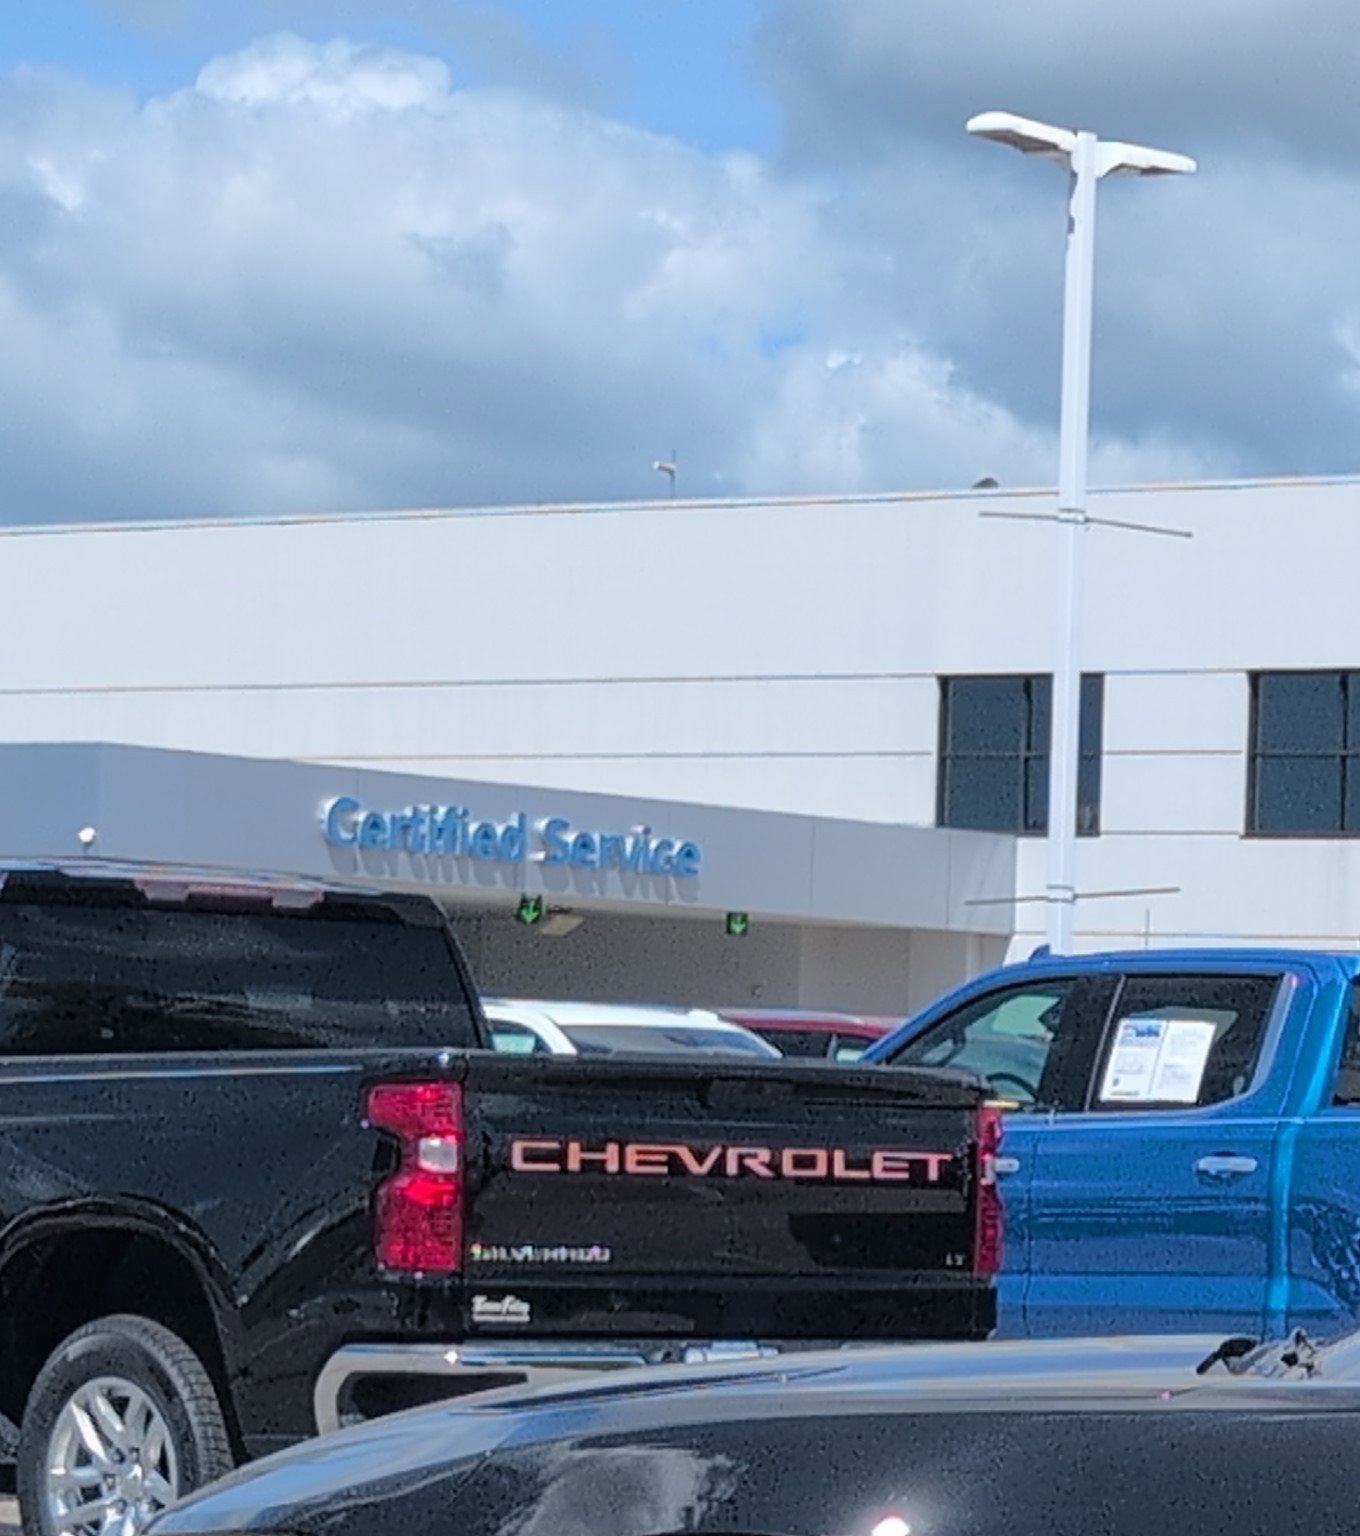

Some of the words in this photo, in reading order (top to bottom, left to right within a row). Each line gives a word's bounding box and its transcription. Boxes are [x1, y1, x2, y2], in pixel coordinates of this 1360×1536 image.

[324, 796, 527, 863] Certified
[539, 817, 702, 879] Service
[510, 1138, 954, 1183] CHEVROLET
